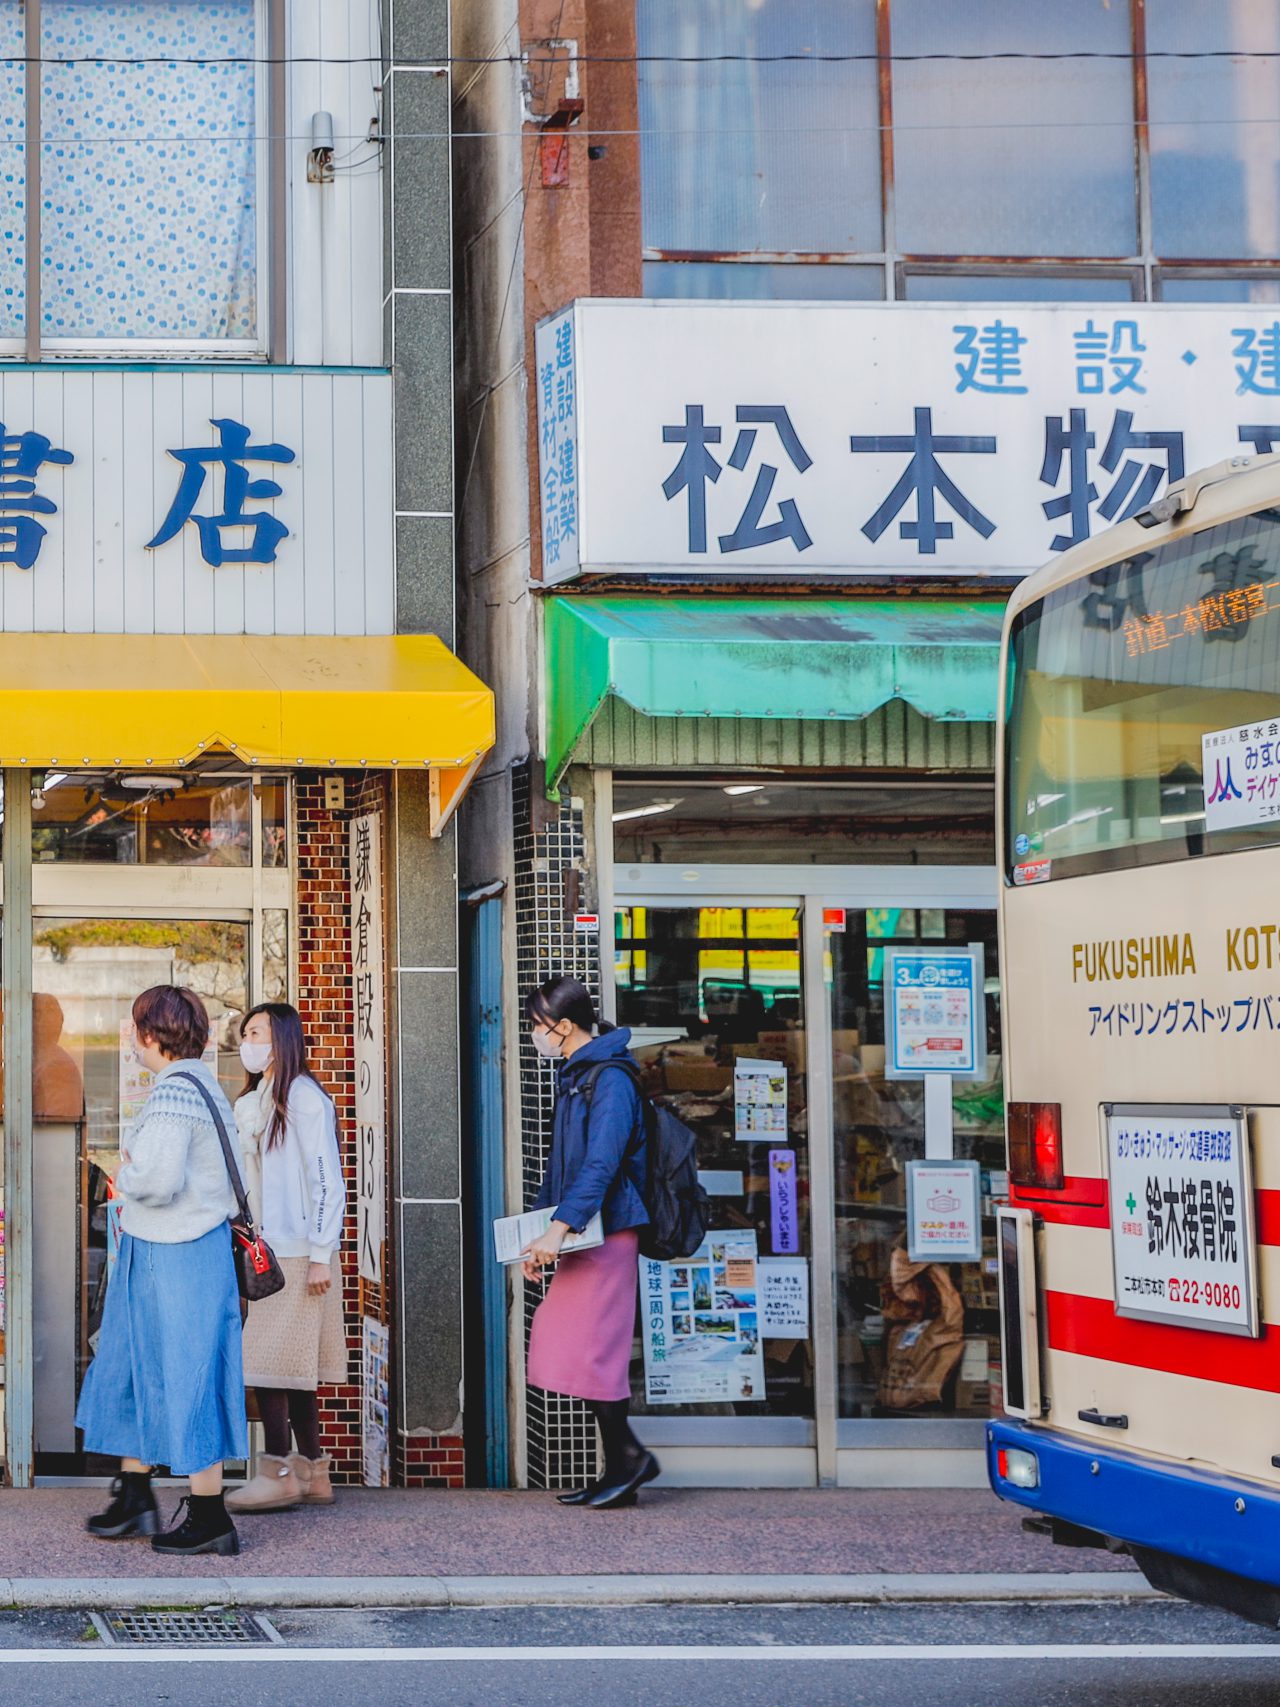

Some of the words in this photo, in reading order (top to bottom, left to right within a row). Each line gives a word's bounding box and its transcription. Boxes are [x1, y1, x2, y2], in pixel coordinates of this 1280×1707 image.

[540, 359, 561, 566] 資材全般
[661, 404, 1280, 554] 松本物
[1072, 932, 1196, 983] FUKUSHIMA
[1226, 925, 1280, 971] KOT
[1088, 995, 1280, 1037] アイドリングストップバ
[777, 1181, 791, 1249] いらっしゃいませ
[1145, 1176, 1237, 1264] 鈴木接骨院
[646, 1261, 667, 1363] 地球一周の船旅
